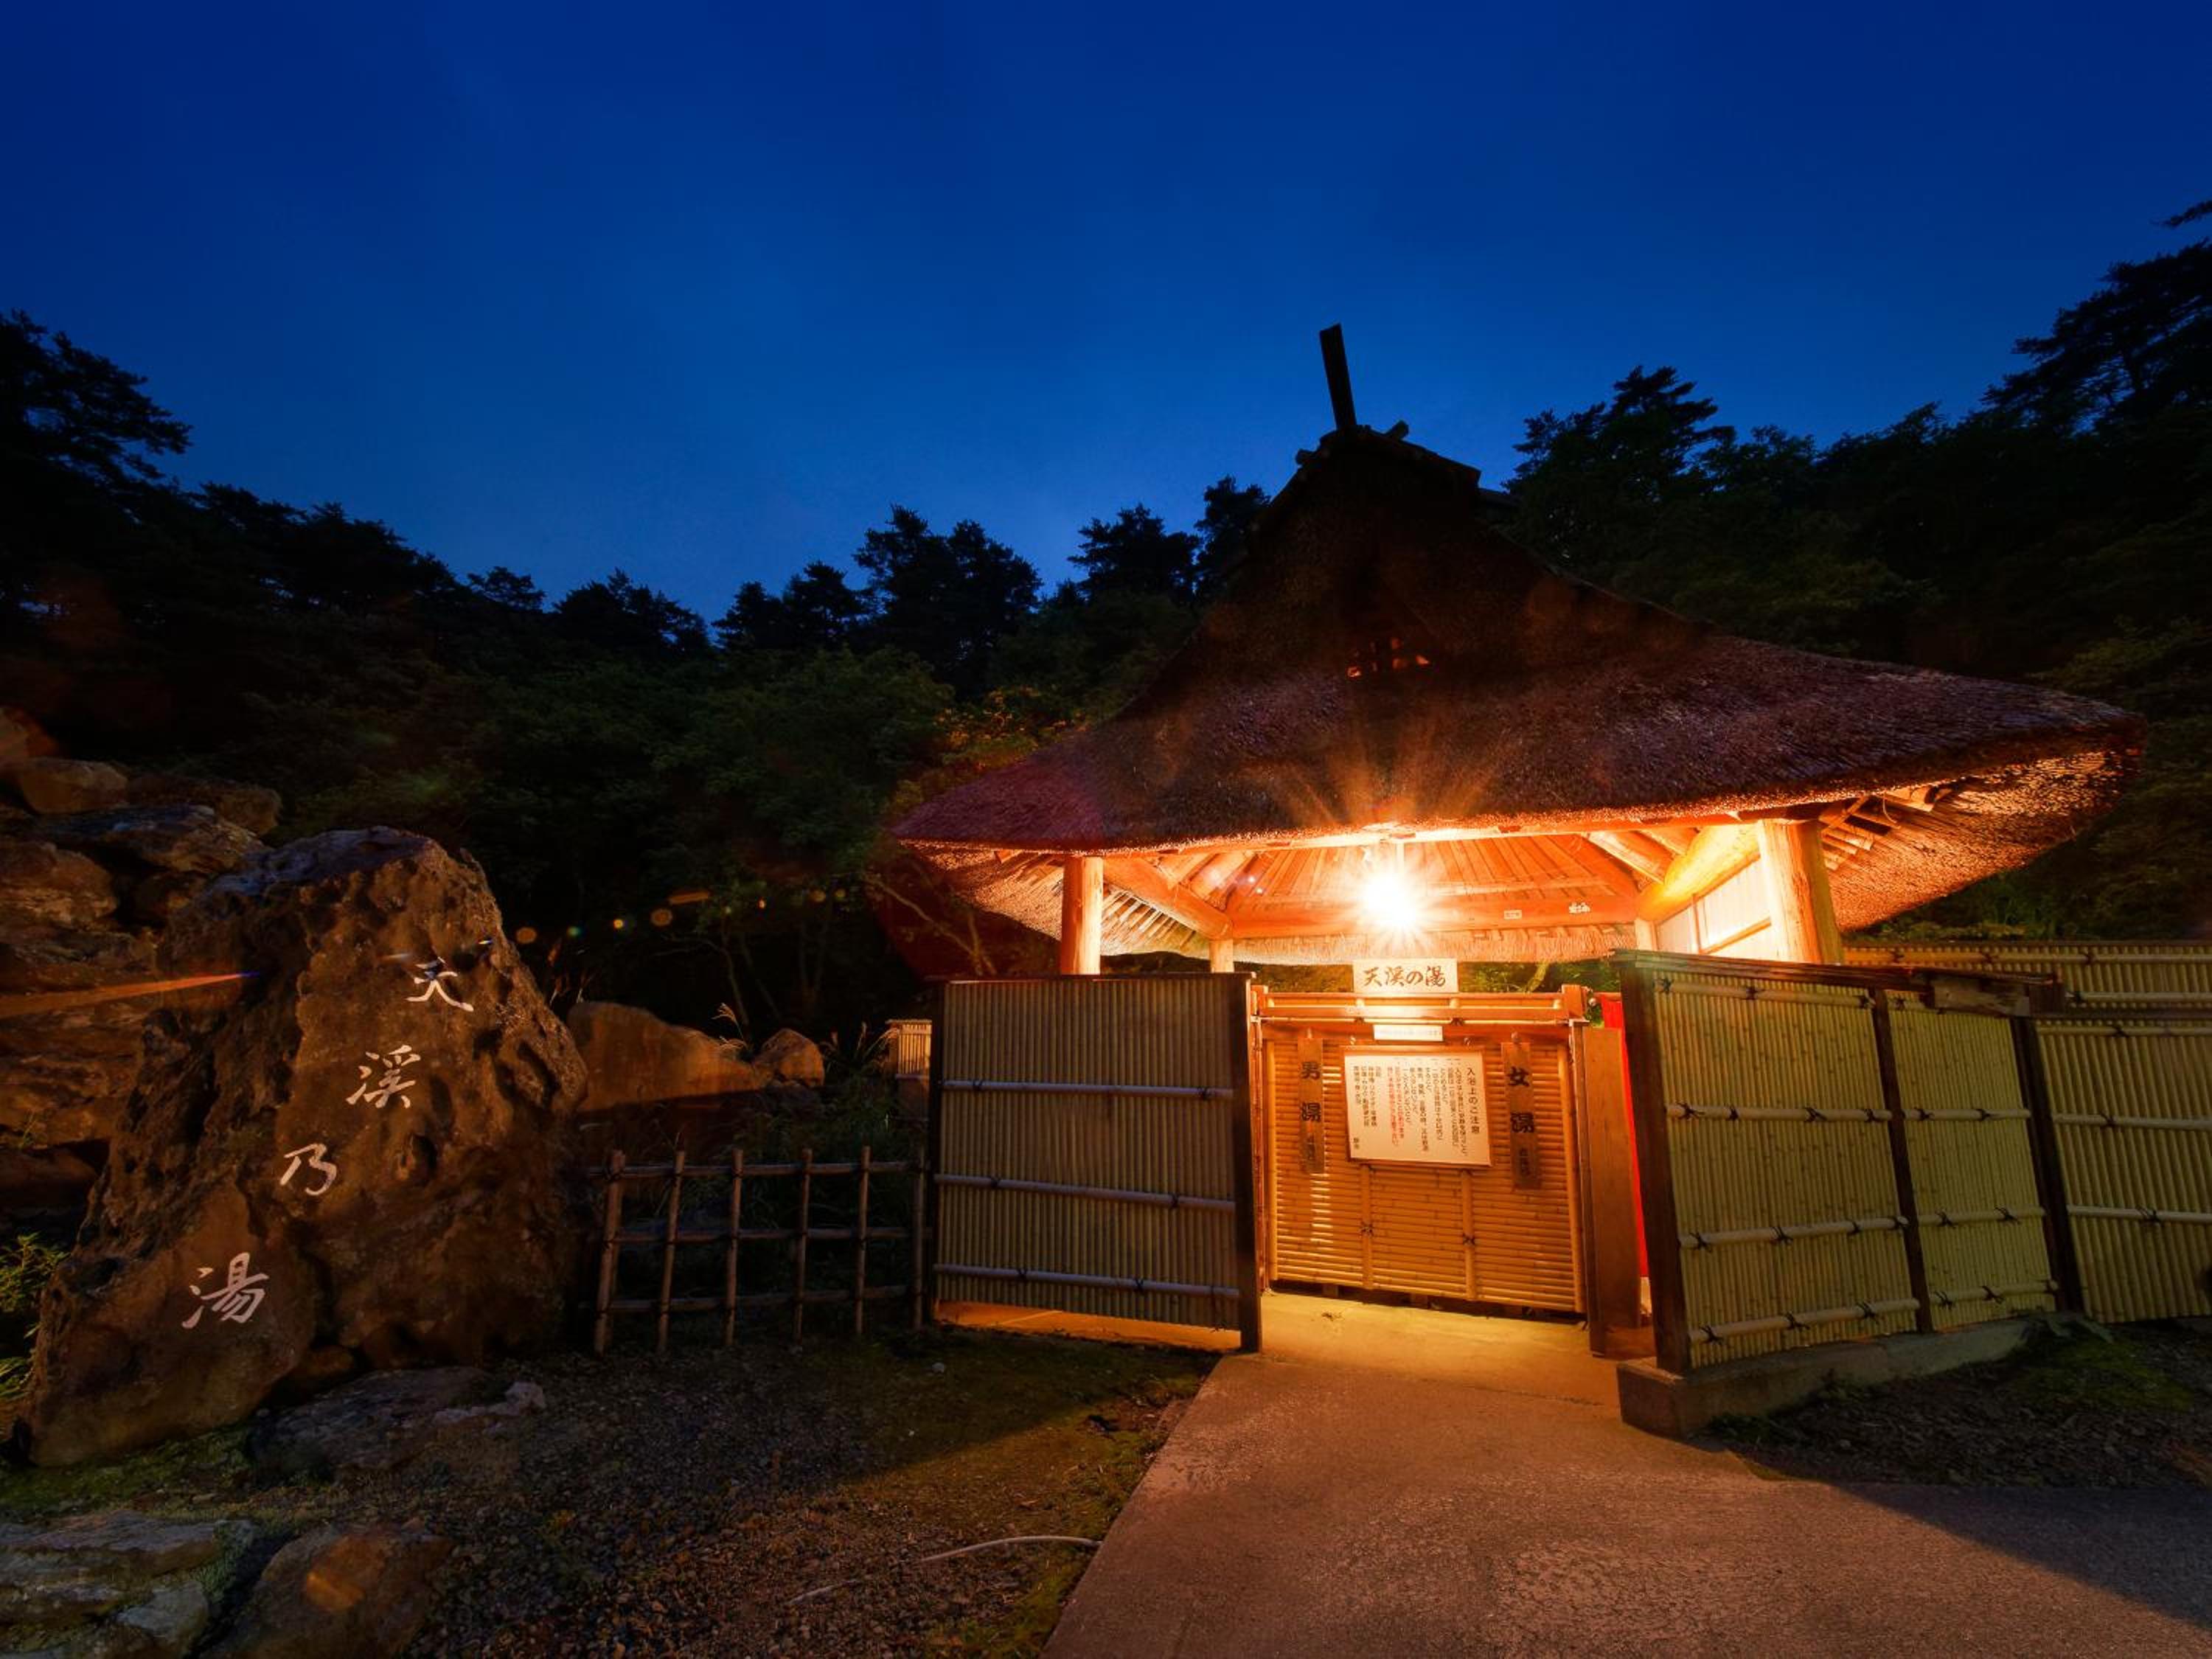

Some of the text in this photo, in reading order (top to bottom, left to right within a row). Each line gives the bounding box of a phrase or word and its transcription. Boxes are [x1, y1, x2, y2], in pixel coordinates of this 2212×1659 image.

[1362, 965, 1446, 987] 天渓の湯
[1301, 1061, 1321, 1122] 男湯
[1507, 1066, 1534, 1134] 女湯
